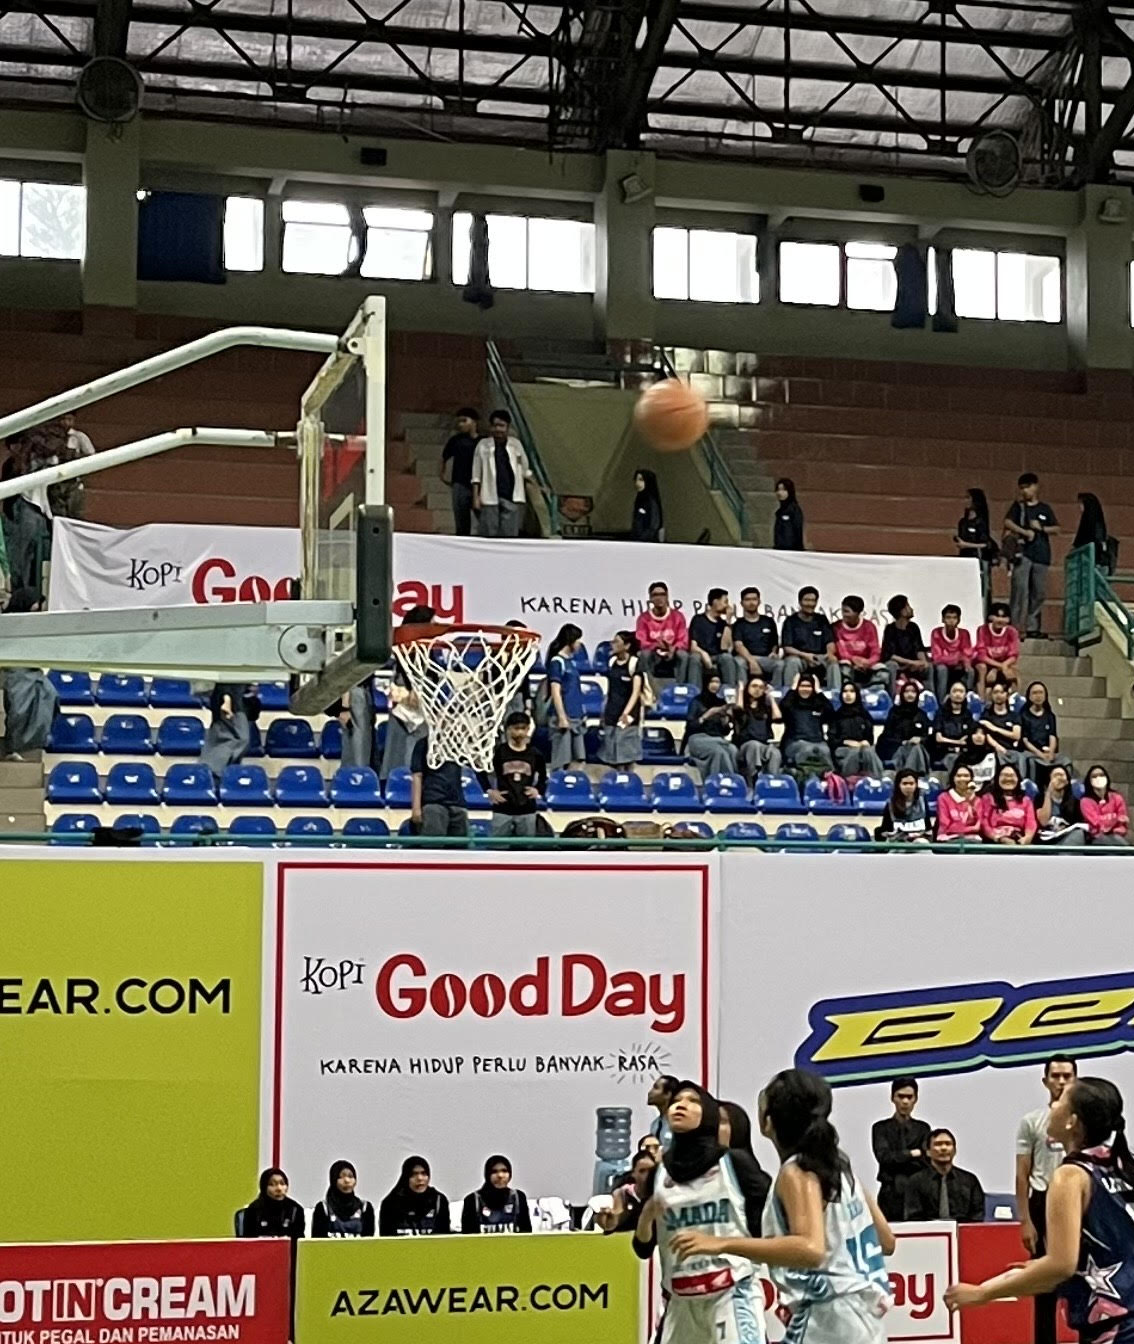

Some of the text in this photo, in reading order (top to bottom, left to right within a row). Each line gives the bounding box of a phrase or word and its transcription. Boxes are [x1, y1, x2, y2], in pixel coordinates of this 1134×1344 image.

[393, 579, 464, 624] ay
[520, 596, 613, 616] KARENA
[375, 953, 550, 1019] Good
[560, 953, 687, 1034] Day
[320, 1055, 660, 1075] KARENA HIDUP PERLU BANYAK RASA
[103, 1274, 256, 1321] CREAM
[330, 1282, 609, 1317] AZAWEAR.COM
[99, 1327, 134, 1344] DAN
[138, 1325, 240, 1343] PEMANASAN
